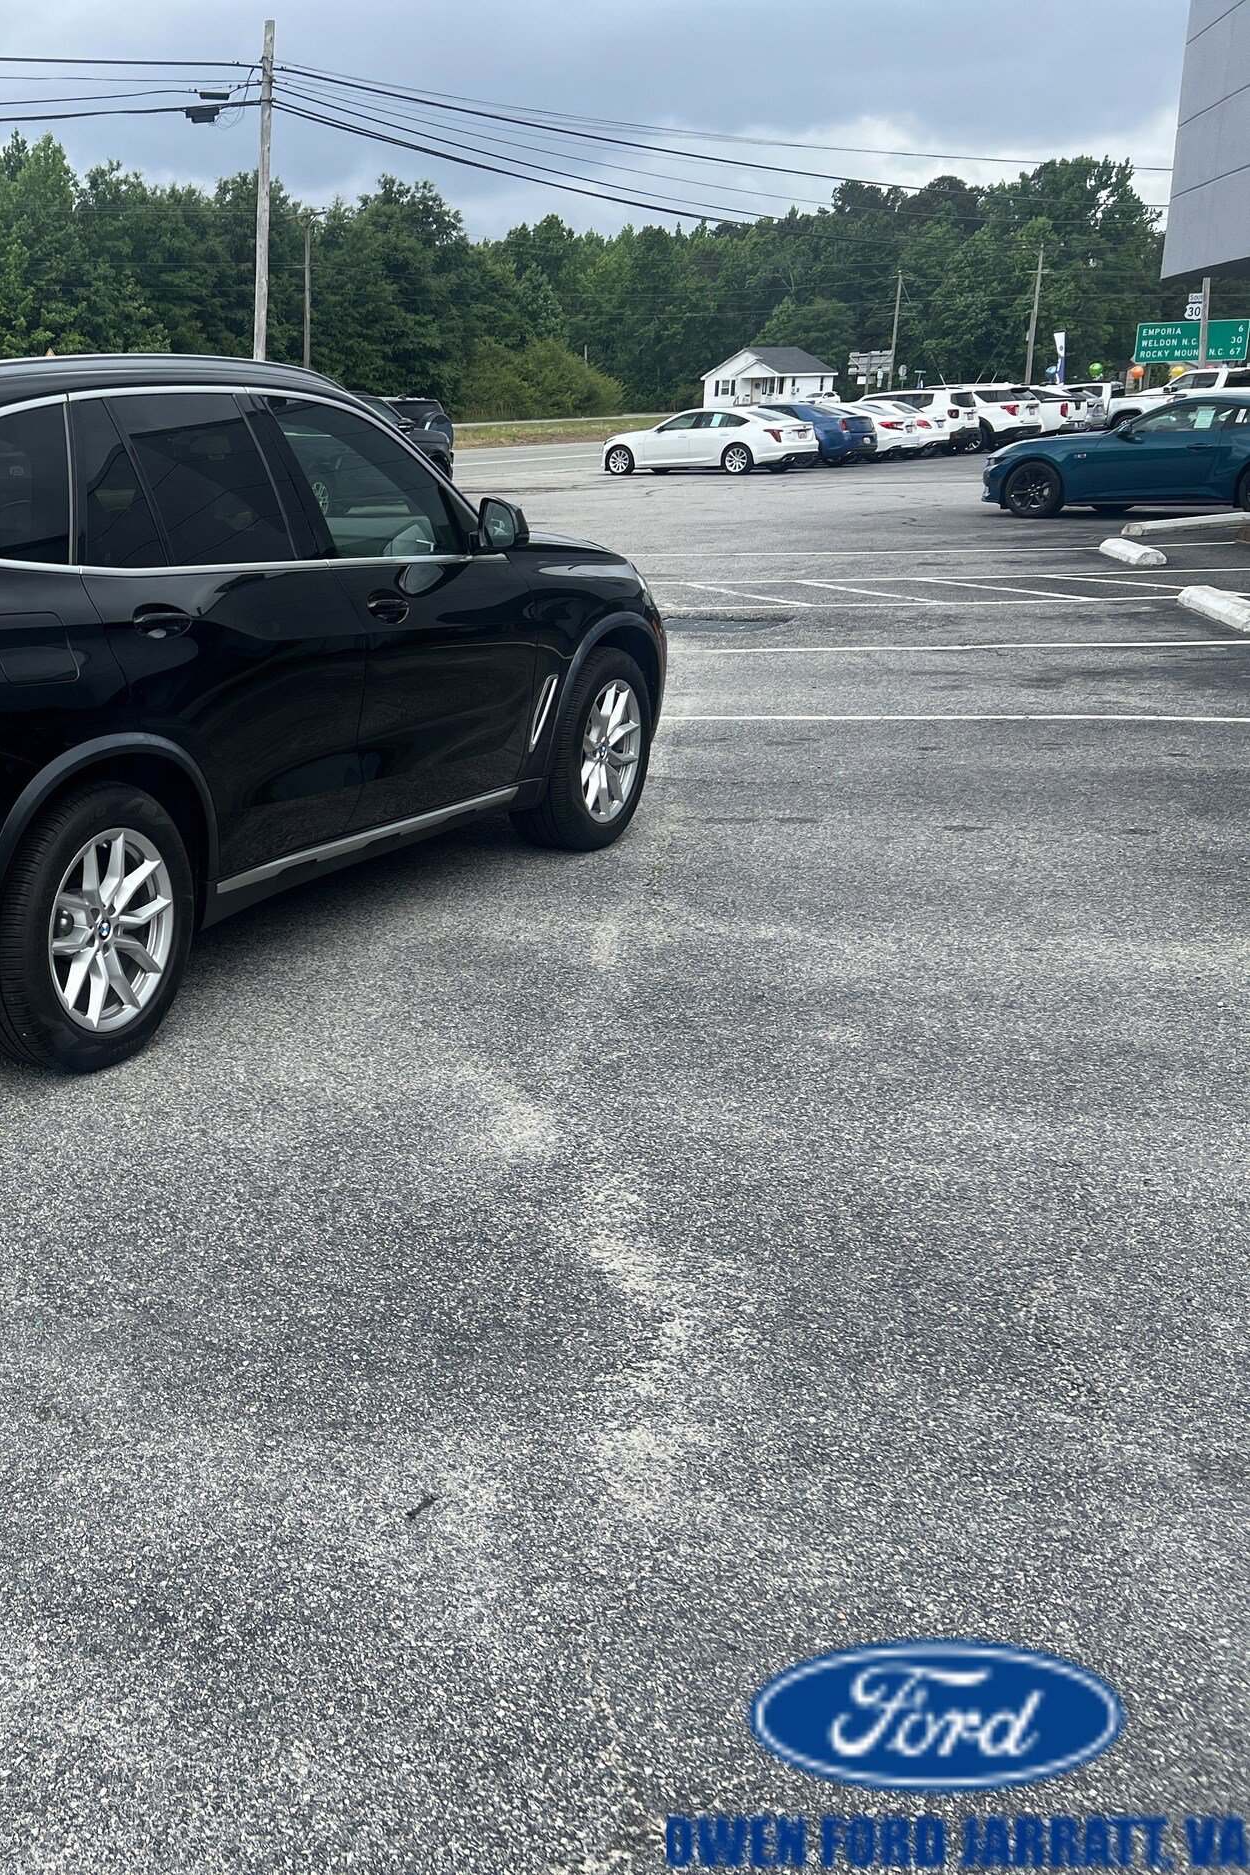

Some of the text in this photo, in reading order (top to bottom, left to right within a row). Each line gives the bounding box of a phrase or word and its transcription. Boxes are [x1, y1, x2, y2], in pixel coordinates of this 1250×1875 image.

[1187, 306, 1201, 317] 30
[1142, 327, 1182, 337] EMPORIA
[1141, 338, 1177, 347] WELDON
[1230, 336, 1243, 344] 30
[1139, 350, 1170, 358] ROCKY
[1174, 349, 1199, 357] MOUN
[1229, 347, 1241, 355] 67
